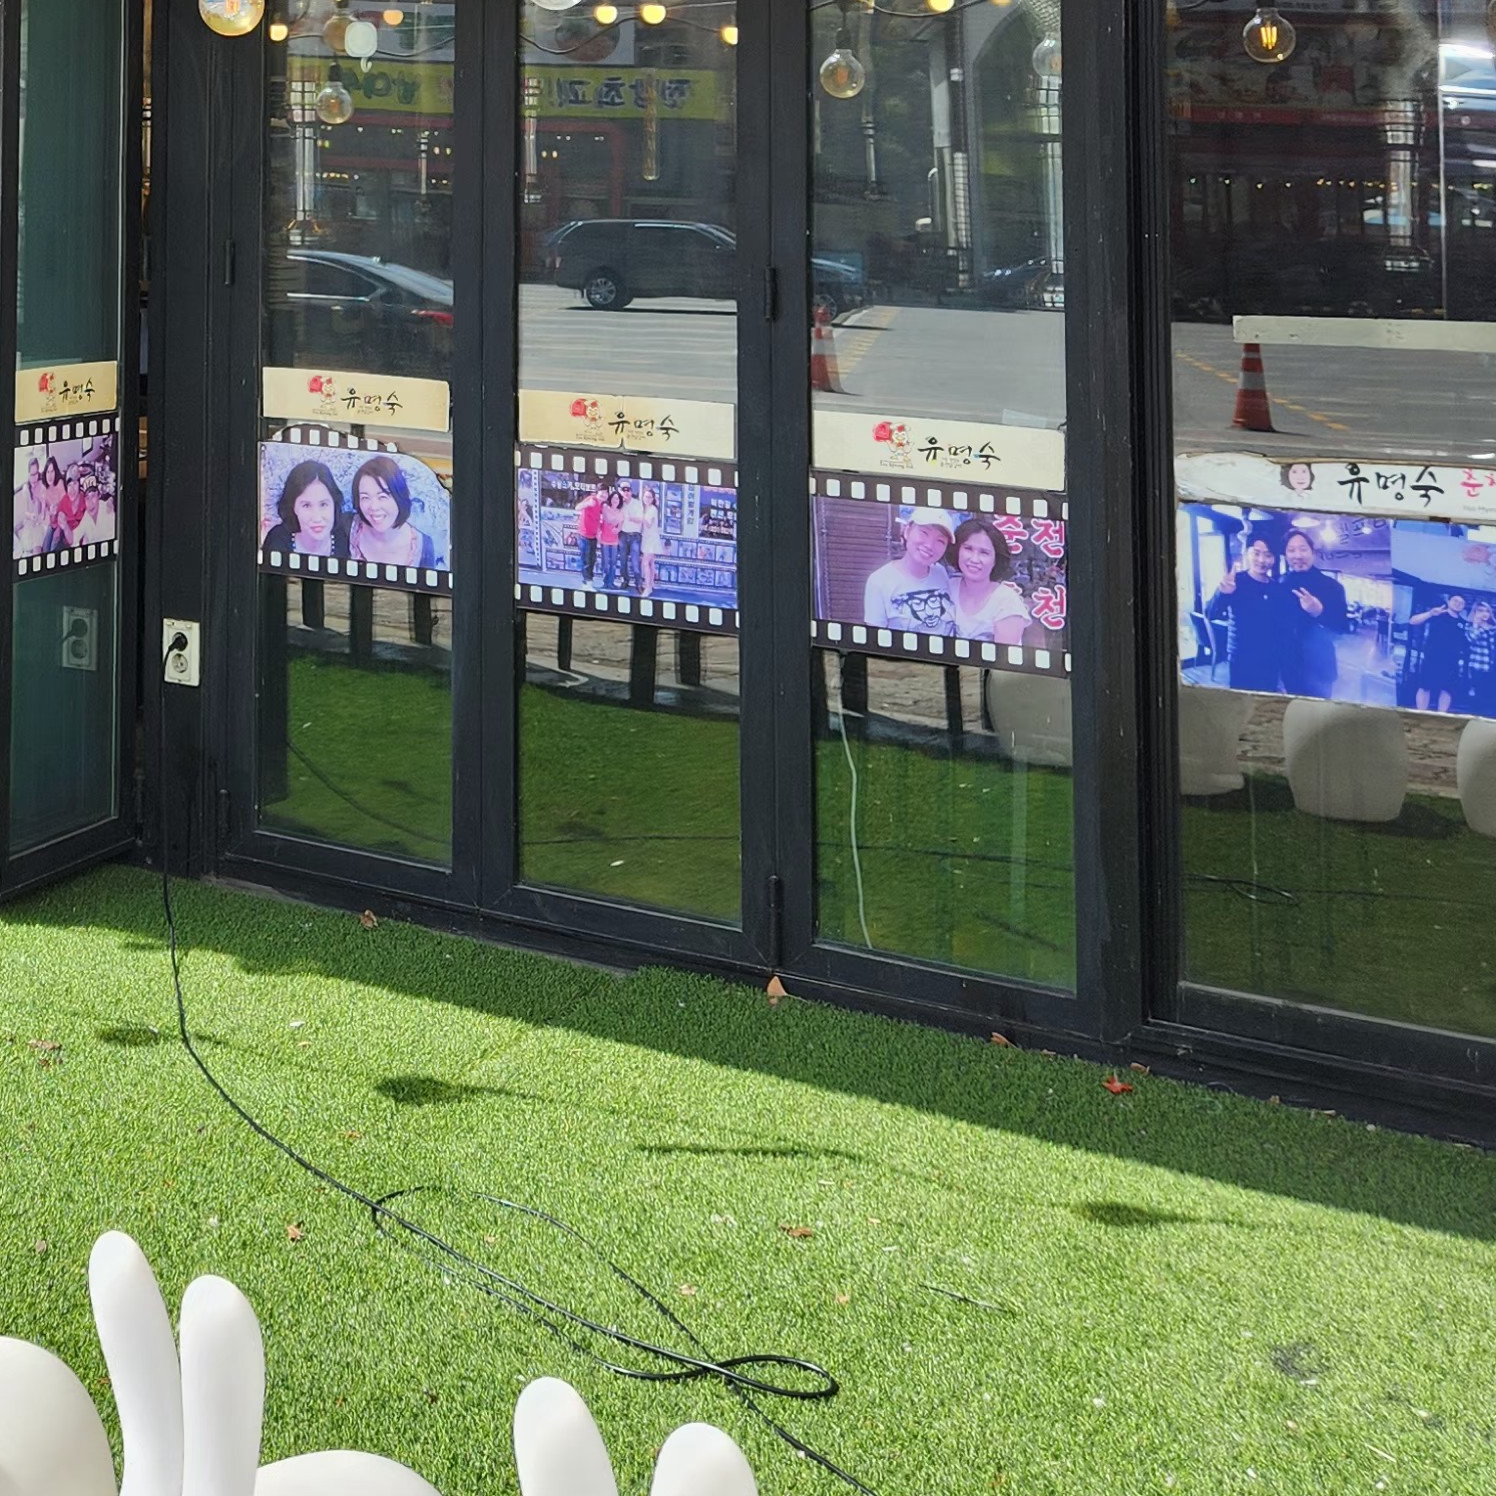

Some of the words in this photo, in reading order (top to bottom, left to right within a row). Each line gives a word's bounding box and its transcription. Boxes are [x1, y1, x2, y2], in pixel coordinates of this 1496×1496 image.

[59, 377, 96, 403] 유명숙
[340, 387, 404, 416] 유명숙
[608, 410, 680, 441] 유명숙
[917, 435, 1002, 471] 유명숙
[1336, 462, 1445, 508] 유명숙
